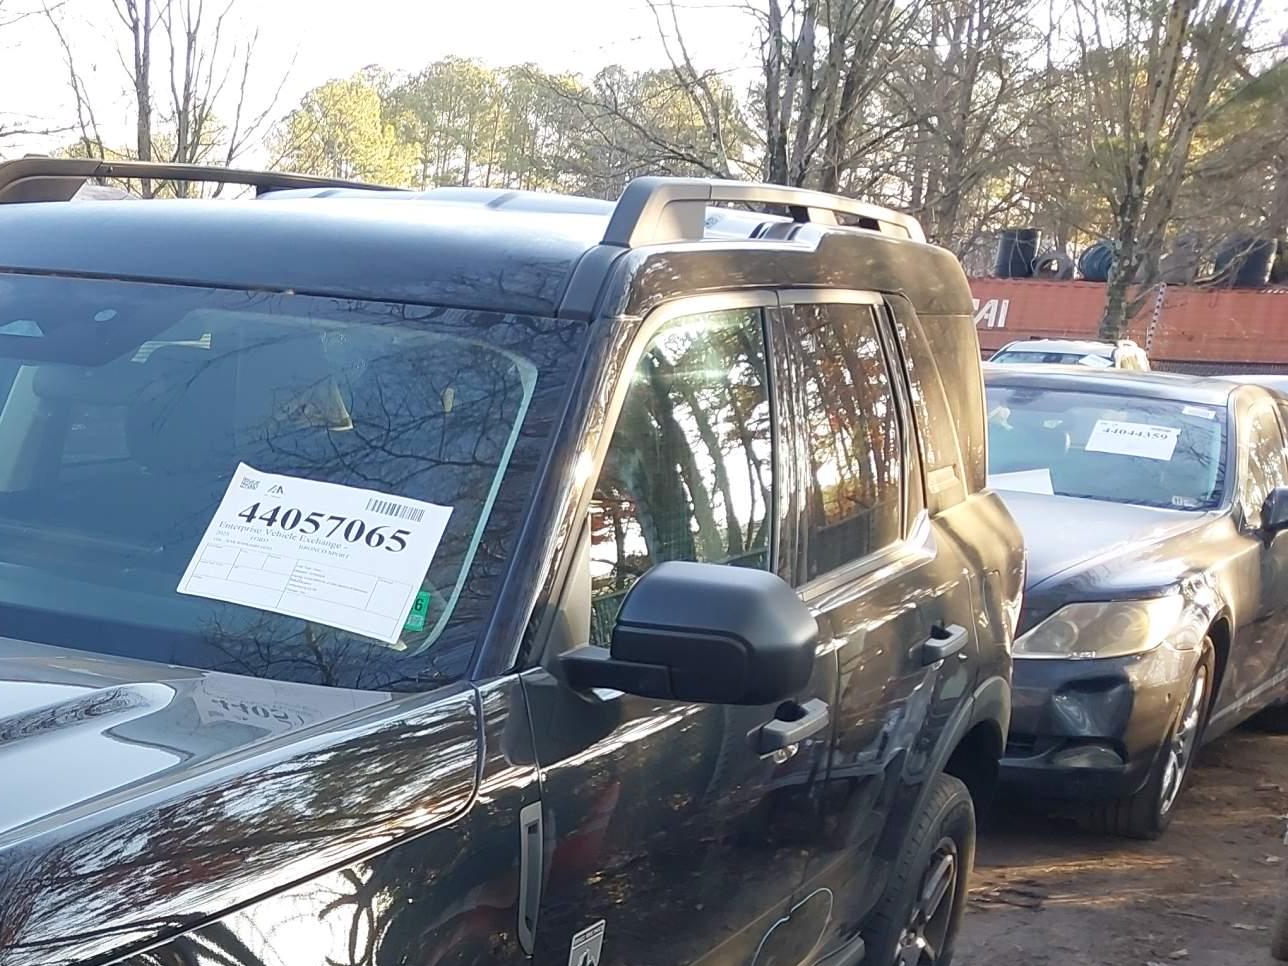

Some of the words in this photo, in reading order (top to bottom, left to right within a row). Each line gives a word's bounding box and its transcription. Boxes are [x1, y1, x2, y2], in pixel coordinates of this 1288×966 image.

[219, 520, 263, 534] Enterprise
[265, 528, 298, 541] Vehicle
[299, 535, 342, 550] Exchange
[238, 502, 412, 552] 44057065
